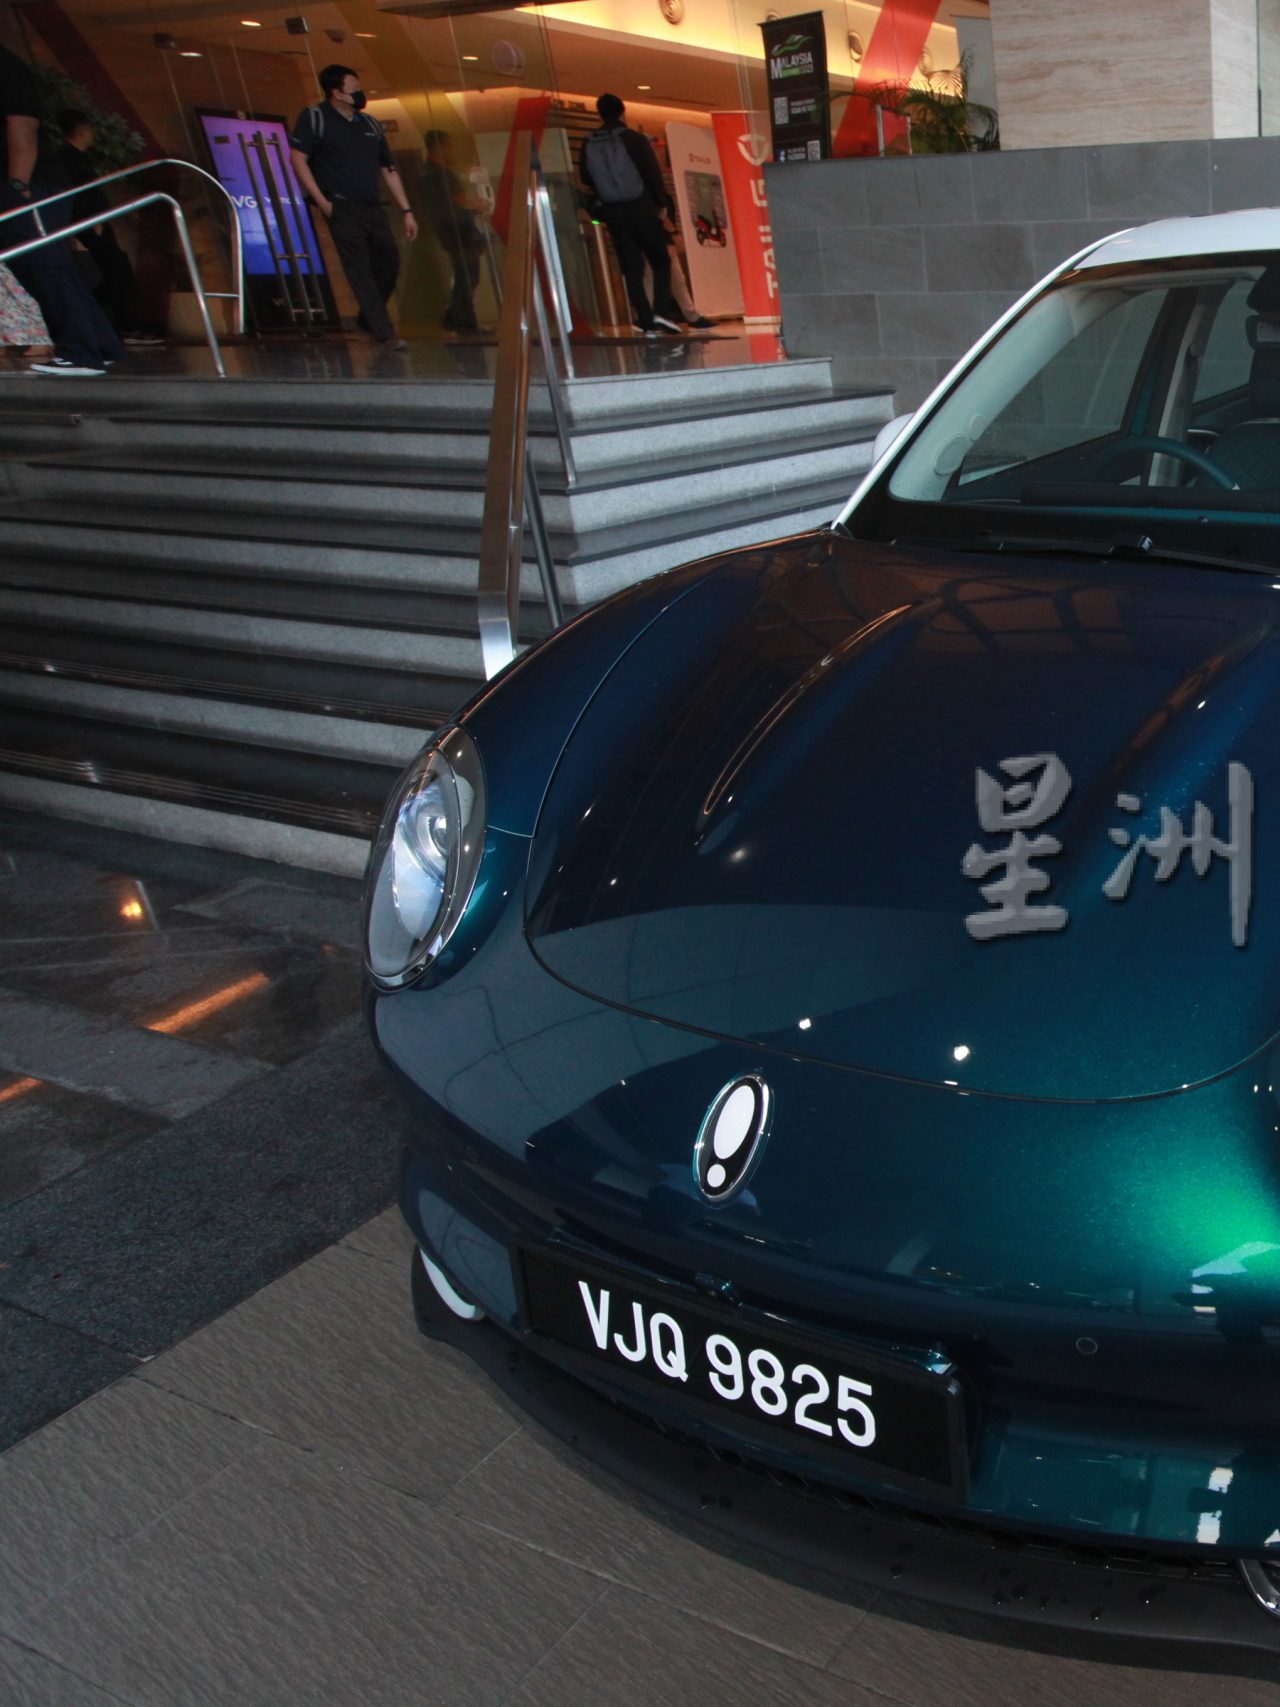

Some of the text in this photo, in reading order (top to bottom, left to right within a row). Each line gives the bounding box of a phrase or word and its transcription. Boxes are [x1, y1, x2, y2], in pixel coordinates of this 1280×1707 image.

[770, 51, 814, 80] MALAYSIA
[578, 1280, 876, 1447] VJQ 9825
